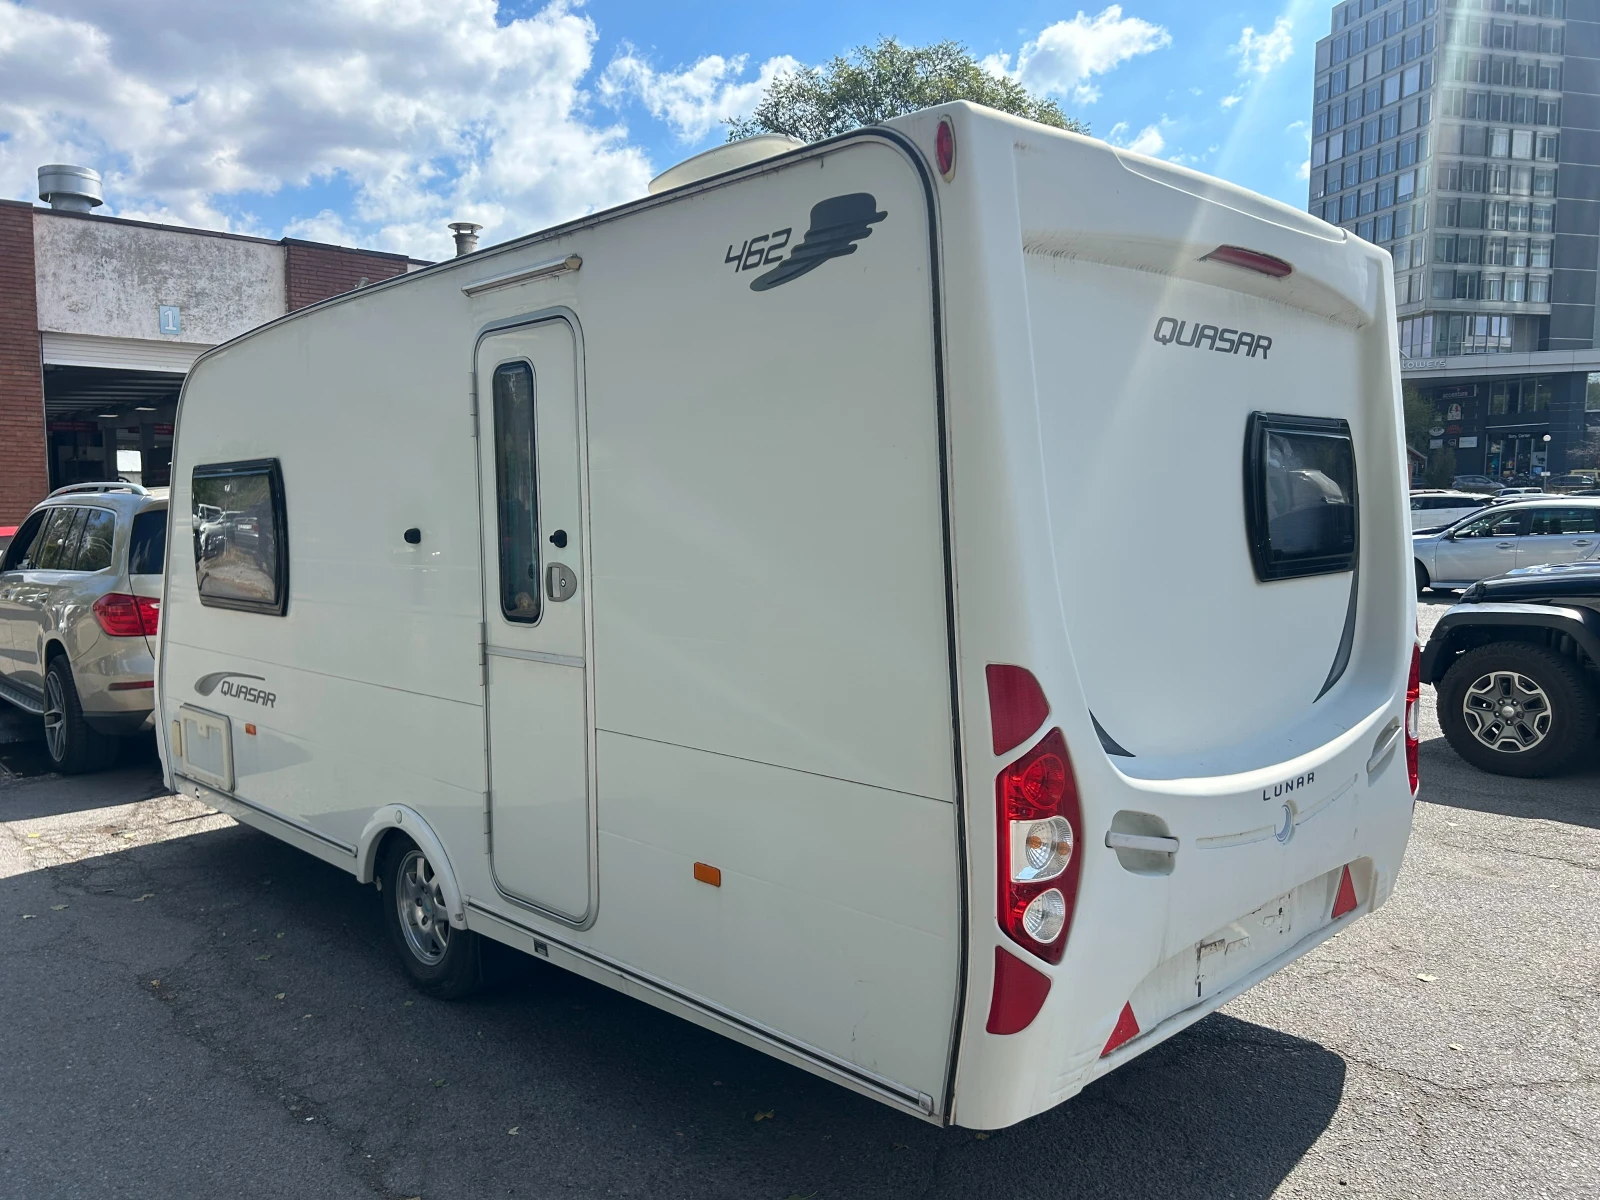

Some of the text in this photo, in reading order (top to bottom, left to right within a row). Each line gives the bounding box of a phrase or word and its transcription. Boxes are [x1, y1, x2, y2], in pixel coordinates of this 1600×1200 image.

[724, 227, 792, 273] 462
[164, 310, 177, 331] 1
[1153, 316, 1273, 360] QUASAR
[1402, 359, 1446, 369] towers
[220, 680, 277, 708] QUASAR
[1262, 771, 1315, 802] LUNAR
